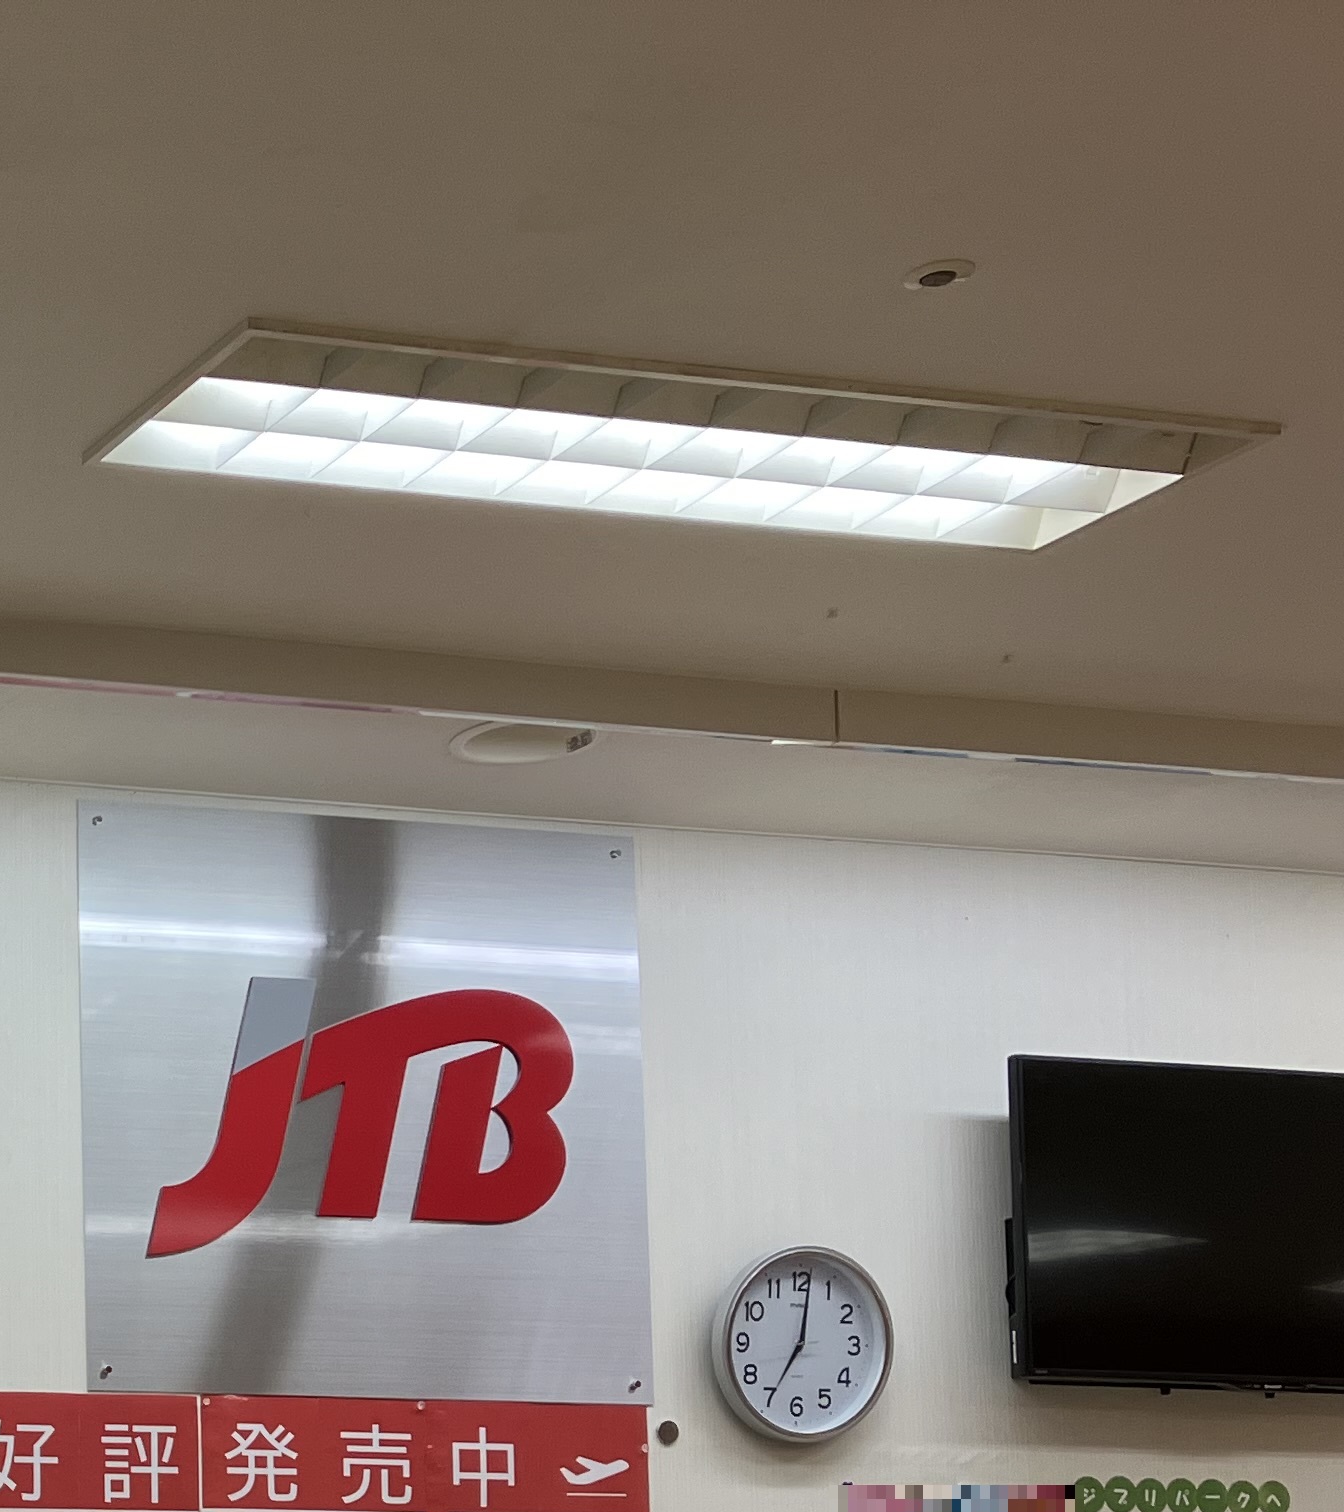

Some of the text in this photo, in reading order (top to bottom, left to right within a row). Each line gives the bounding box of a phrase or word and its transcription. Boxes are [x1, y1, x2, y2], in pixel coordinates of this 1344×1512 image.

[145, 977, 574, 1259] JTB
[767, 1278, 781, 1299] 11
[792, 1271, 811, 1292] 12
[825, 1280, 831, 1300] 1
[744, 1301, 764, 1321] 10
[840, 1304, 854, 1324] 2
[736, 1332, 750, 1353] 9
[847, 1335, 861, 1356] 3
[743, 1364, 758, 1385] 8
[837, 1367, 852, 1387] 4
[763, 1387, 777, 1407] 7
[790, 1396, 803, 1417] 6
[818, 1389, 832, 1409] 5
